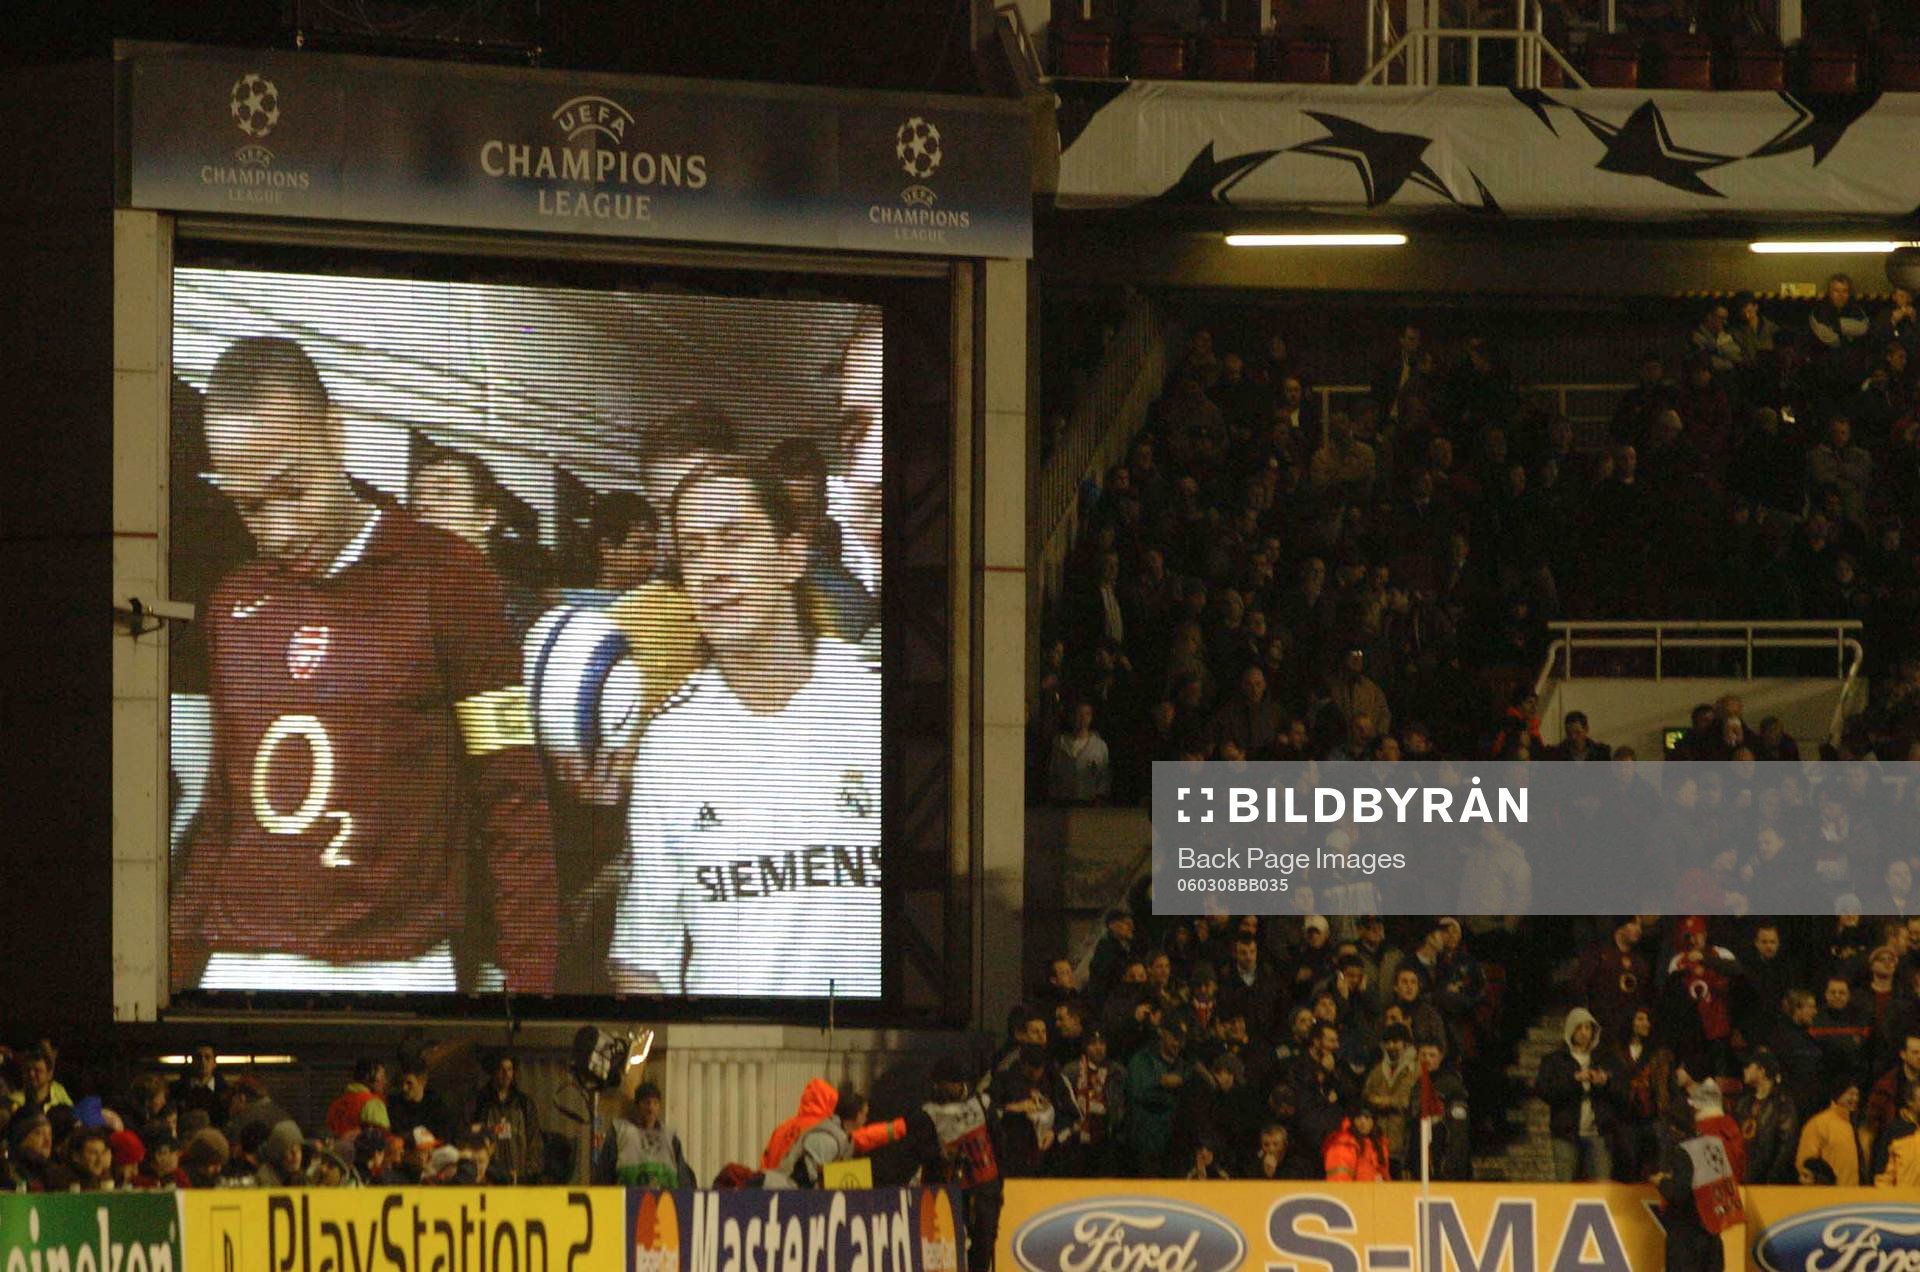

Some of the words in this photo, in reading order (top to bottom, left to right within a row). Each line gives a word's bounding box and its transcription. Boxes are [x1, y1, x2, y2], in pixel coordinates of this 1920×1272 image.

[559, 104, 626, 138] UEFA
[201, 165, 310, 189] CHAMPIONS
[480, 140, 708, 189] CHAMPIONS
[538, 189, 653, 221] LEAGUE
[869, 205, 971, 229] CHAMPIONS
[267, 1193, 549, 1272] PlayStation
[566, 1192, 594, 1272] 2
[690, 1189, 912, 1272] MasterCard
[1059, 1211, 1200, 1272] Ford
[1266, 1194, 1668, 1272] S-MA
[1805, 1216, 1920, 1272] For
